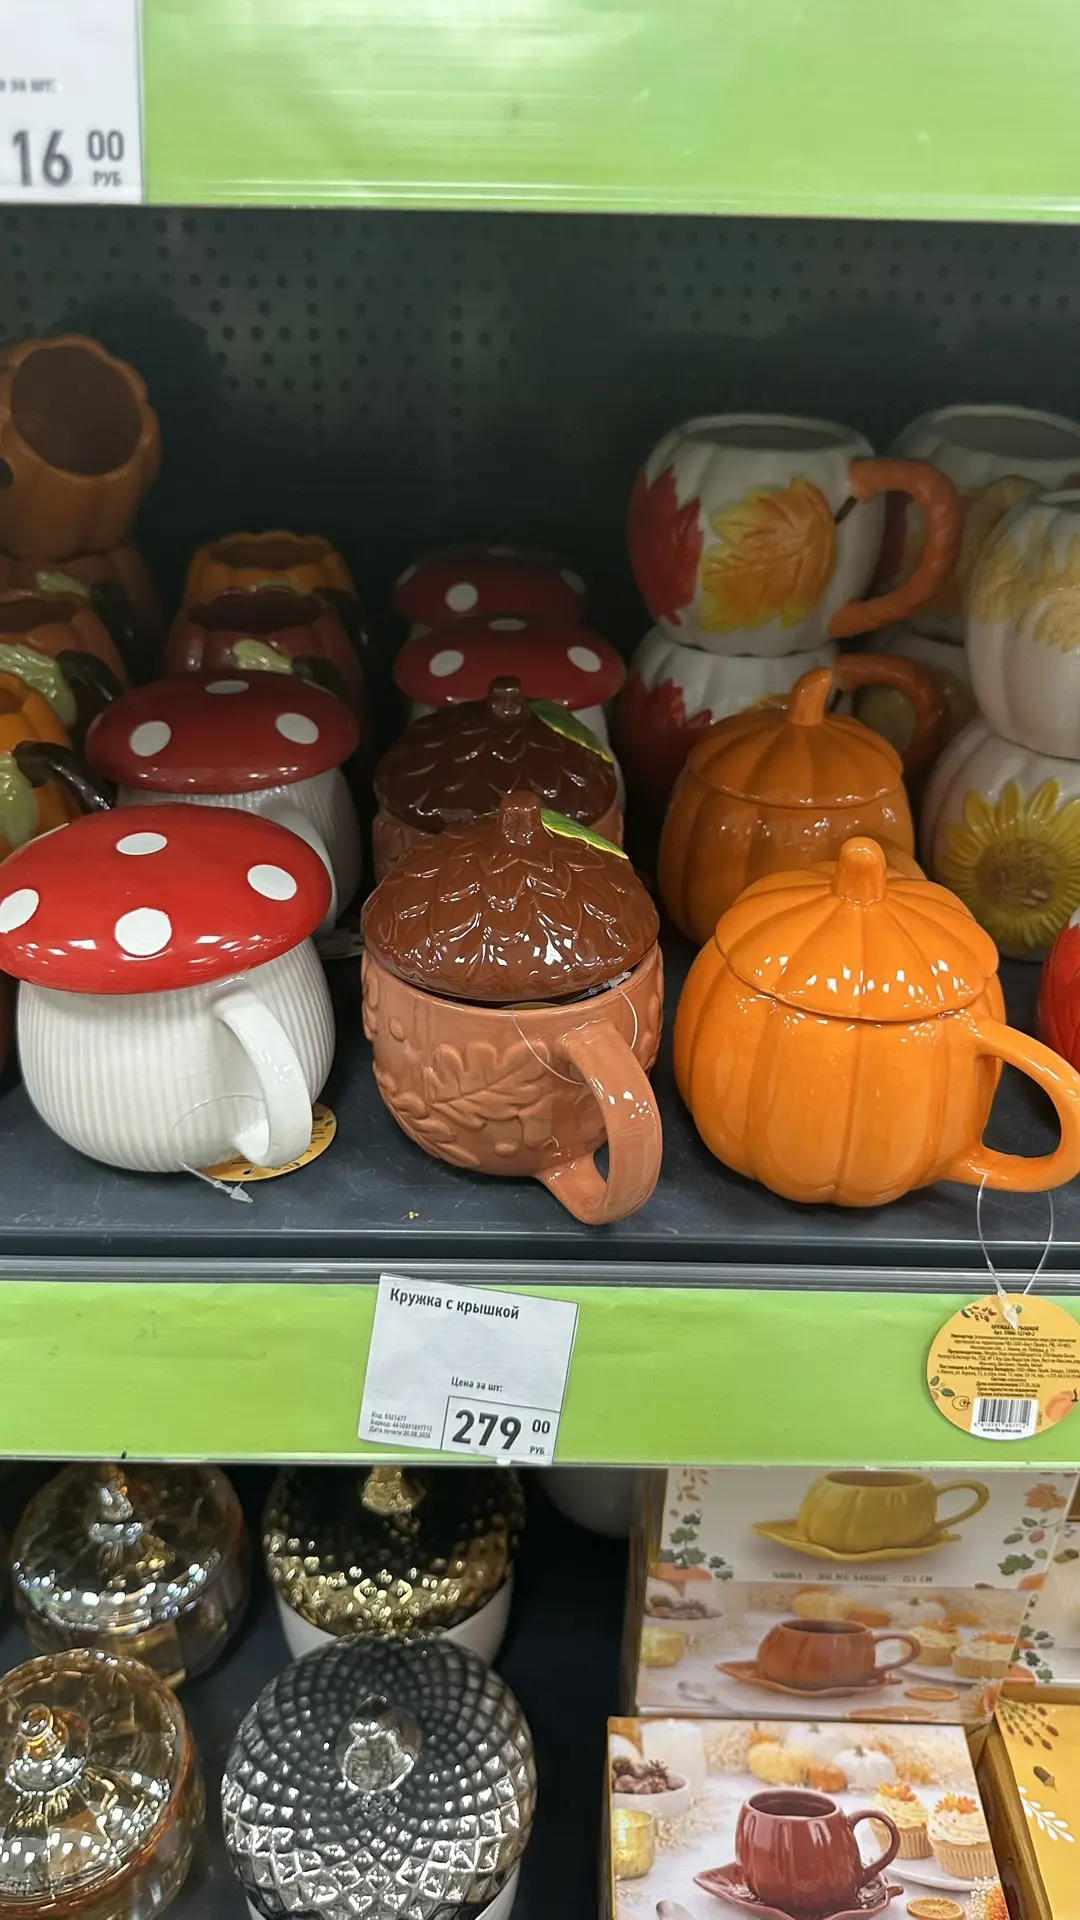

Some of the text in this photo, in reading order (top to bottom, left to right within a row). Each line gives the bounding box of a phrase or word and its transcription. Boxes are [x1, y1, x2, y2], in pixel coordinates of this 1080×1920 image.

[87, 129, 124, 161] 00
[12, 129, 73, 188] 16
[93, 170, 122, 187] РУБ
[390, 1287, 520, 1319] Кружка с крышкой
[451, 1376, 503, 1392] Цена за шт:
[452, 1409, 521, 1450] 279
[532, 1419, 550, 1434] 00
[530, 1445, 545, 1455] РУБ
